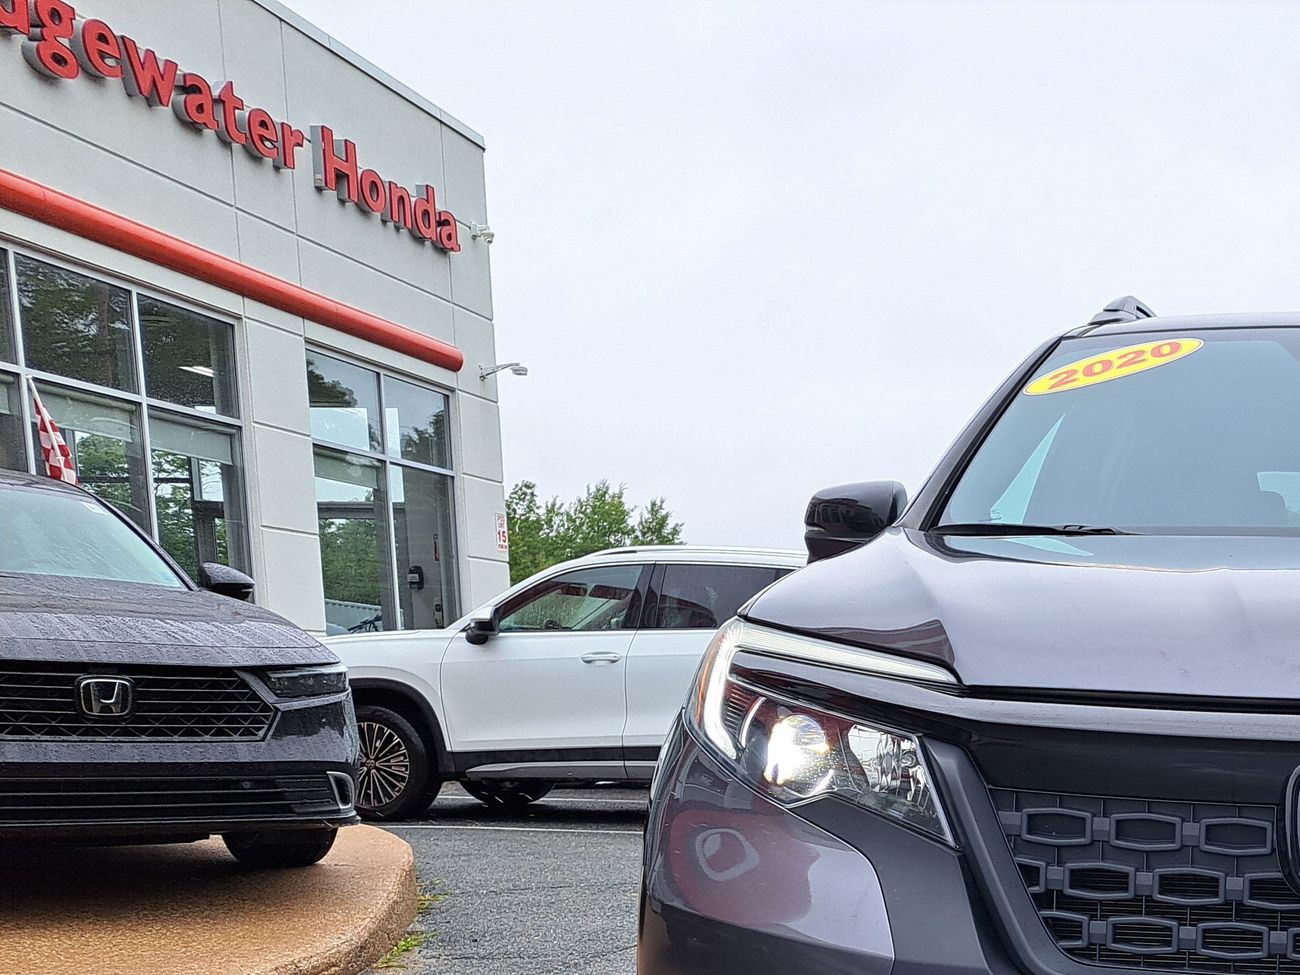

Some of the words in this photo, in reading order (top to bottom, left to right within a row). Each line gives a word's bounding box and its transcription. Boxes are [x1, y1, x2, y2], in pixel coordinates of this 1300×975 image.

[320, 124, 461, 253] Honda
[1047, 341, 1183, 391] 2020
[497, 529, 507, 543] 15
